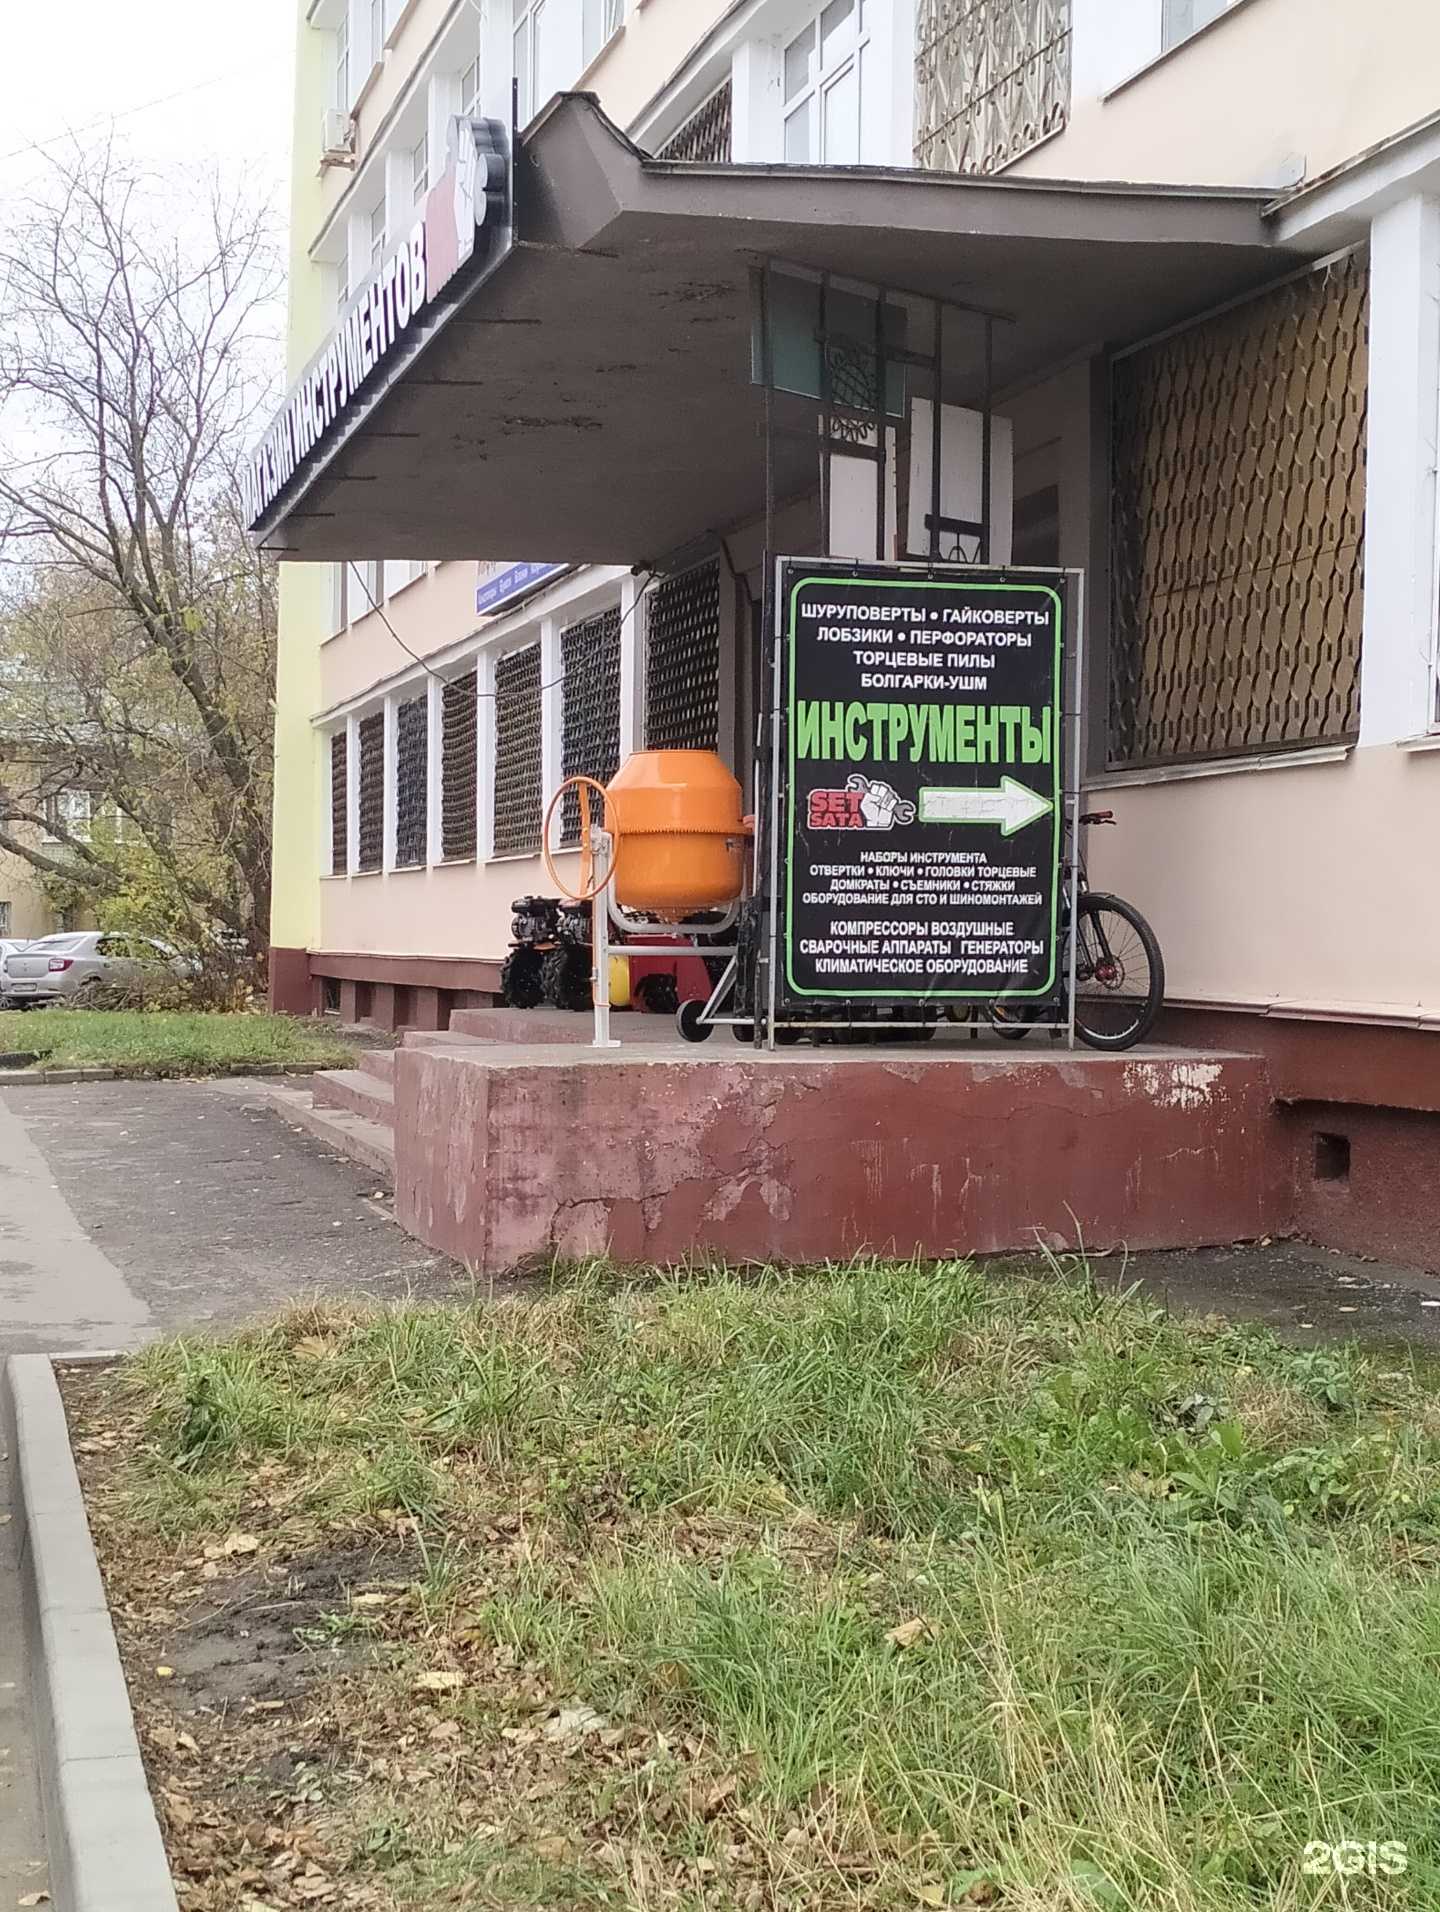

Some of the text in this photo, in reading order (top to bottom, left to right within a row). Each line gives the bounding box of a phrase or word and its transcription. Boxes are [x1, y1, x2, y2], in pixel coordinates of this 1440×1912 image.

[292, 220, 427, 464] ИНСТРУМЕНТОВ
[801, 603, 1049, 625] ШУРУПОВЕРТЫ ГАЙКОВЕРТЫ
[817, 627, 1032, 647] ЛОБЗИКИ ПЕРФОРАТОРЫ
[854, 650, 995, 669] ТОРЦЕВЫЕ ПИЛЫ
[861, 674, 987, 690] БОЛГАРКИ-УШМ
[797, 700, 1051, 764] ИНСТРУМЕНТЫ
[811, 792, 864, 812] SET
[811, 813, 863, 826] SATA
[860, 851, 987, 864] НАБОРЫ ИНСТРУМЕНТА
[810, 865, 1037, 879] ОТВЕРТКИ КЛЮЧИ ГОЛОВКИ ТОРЦЕВЫЕ
[830, 879, 1015, 891] ДОМКРАТЫ СЪЕМНИКИ СТЯЖКИ
[803, 892, 1042, 905] ОБОРУДОВАНИЕ ДЛЯ СТО И ШИНОМОНТАЖЕЙ
[831, 921, 1014, 937] КОМПРЕССОРЫ ВОЗДУШНЫЕ
[800, 940, 1044, 955] СВАРОЧНЫЕ АППАРАТЫ ГЕНЕРАТОРЫ
[815, 959, 1028, 975] КЛИМАТИЧЕСКОЕ ОБОРУДОВАНИЕ
